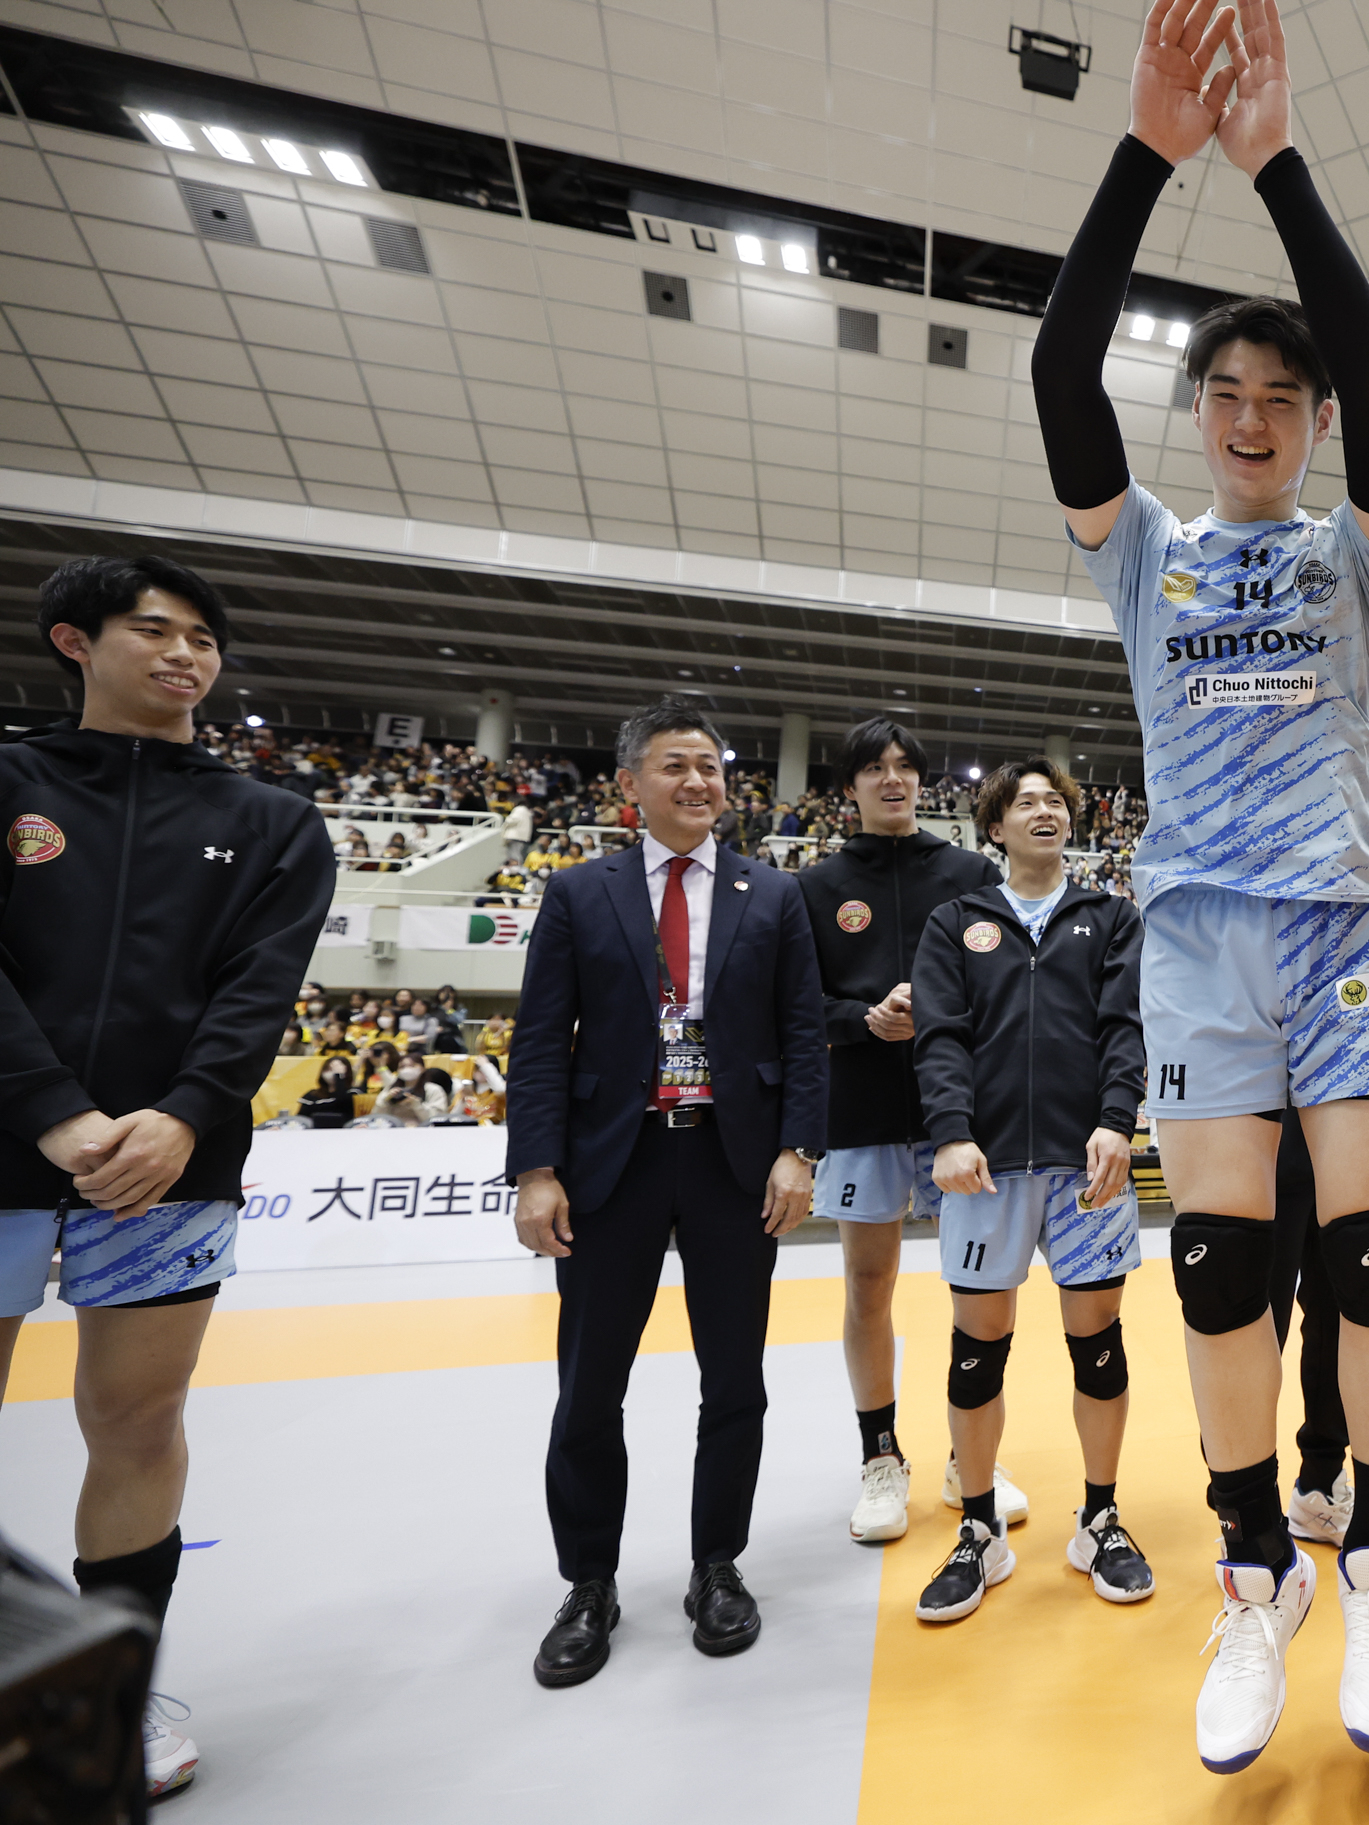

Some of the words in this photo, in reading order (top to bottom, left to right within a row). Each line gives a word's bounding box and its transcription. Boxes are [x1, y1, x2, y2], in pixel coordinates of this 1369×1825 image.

[1233, 579, 1273, 610] 14
[1165, 629, 1327, 663] SUNTORY
[1212, 679, 1250, 692] Chuo
[1255, 676, 1313, 690] Nittochi
[1212, 694, 1298, 704] 中央日本土地建物グループ
[388, 717, 412, 738] E
[678, 1086, 700, 1096] TEAM
[1159, 1063, 1187, 1100] 14
[840, 1183, 856, 1207] 2
[962, 1240, 987, 1272] 11
